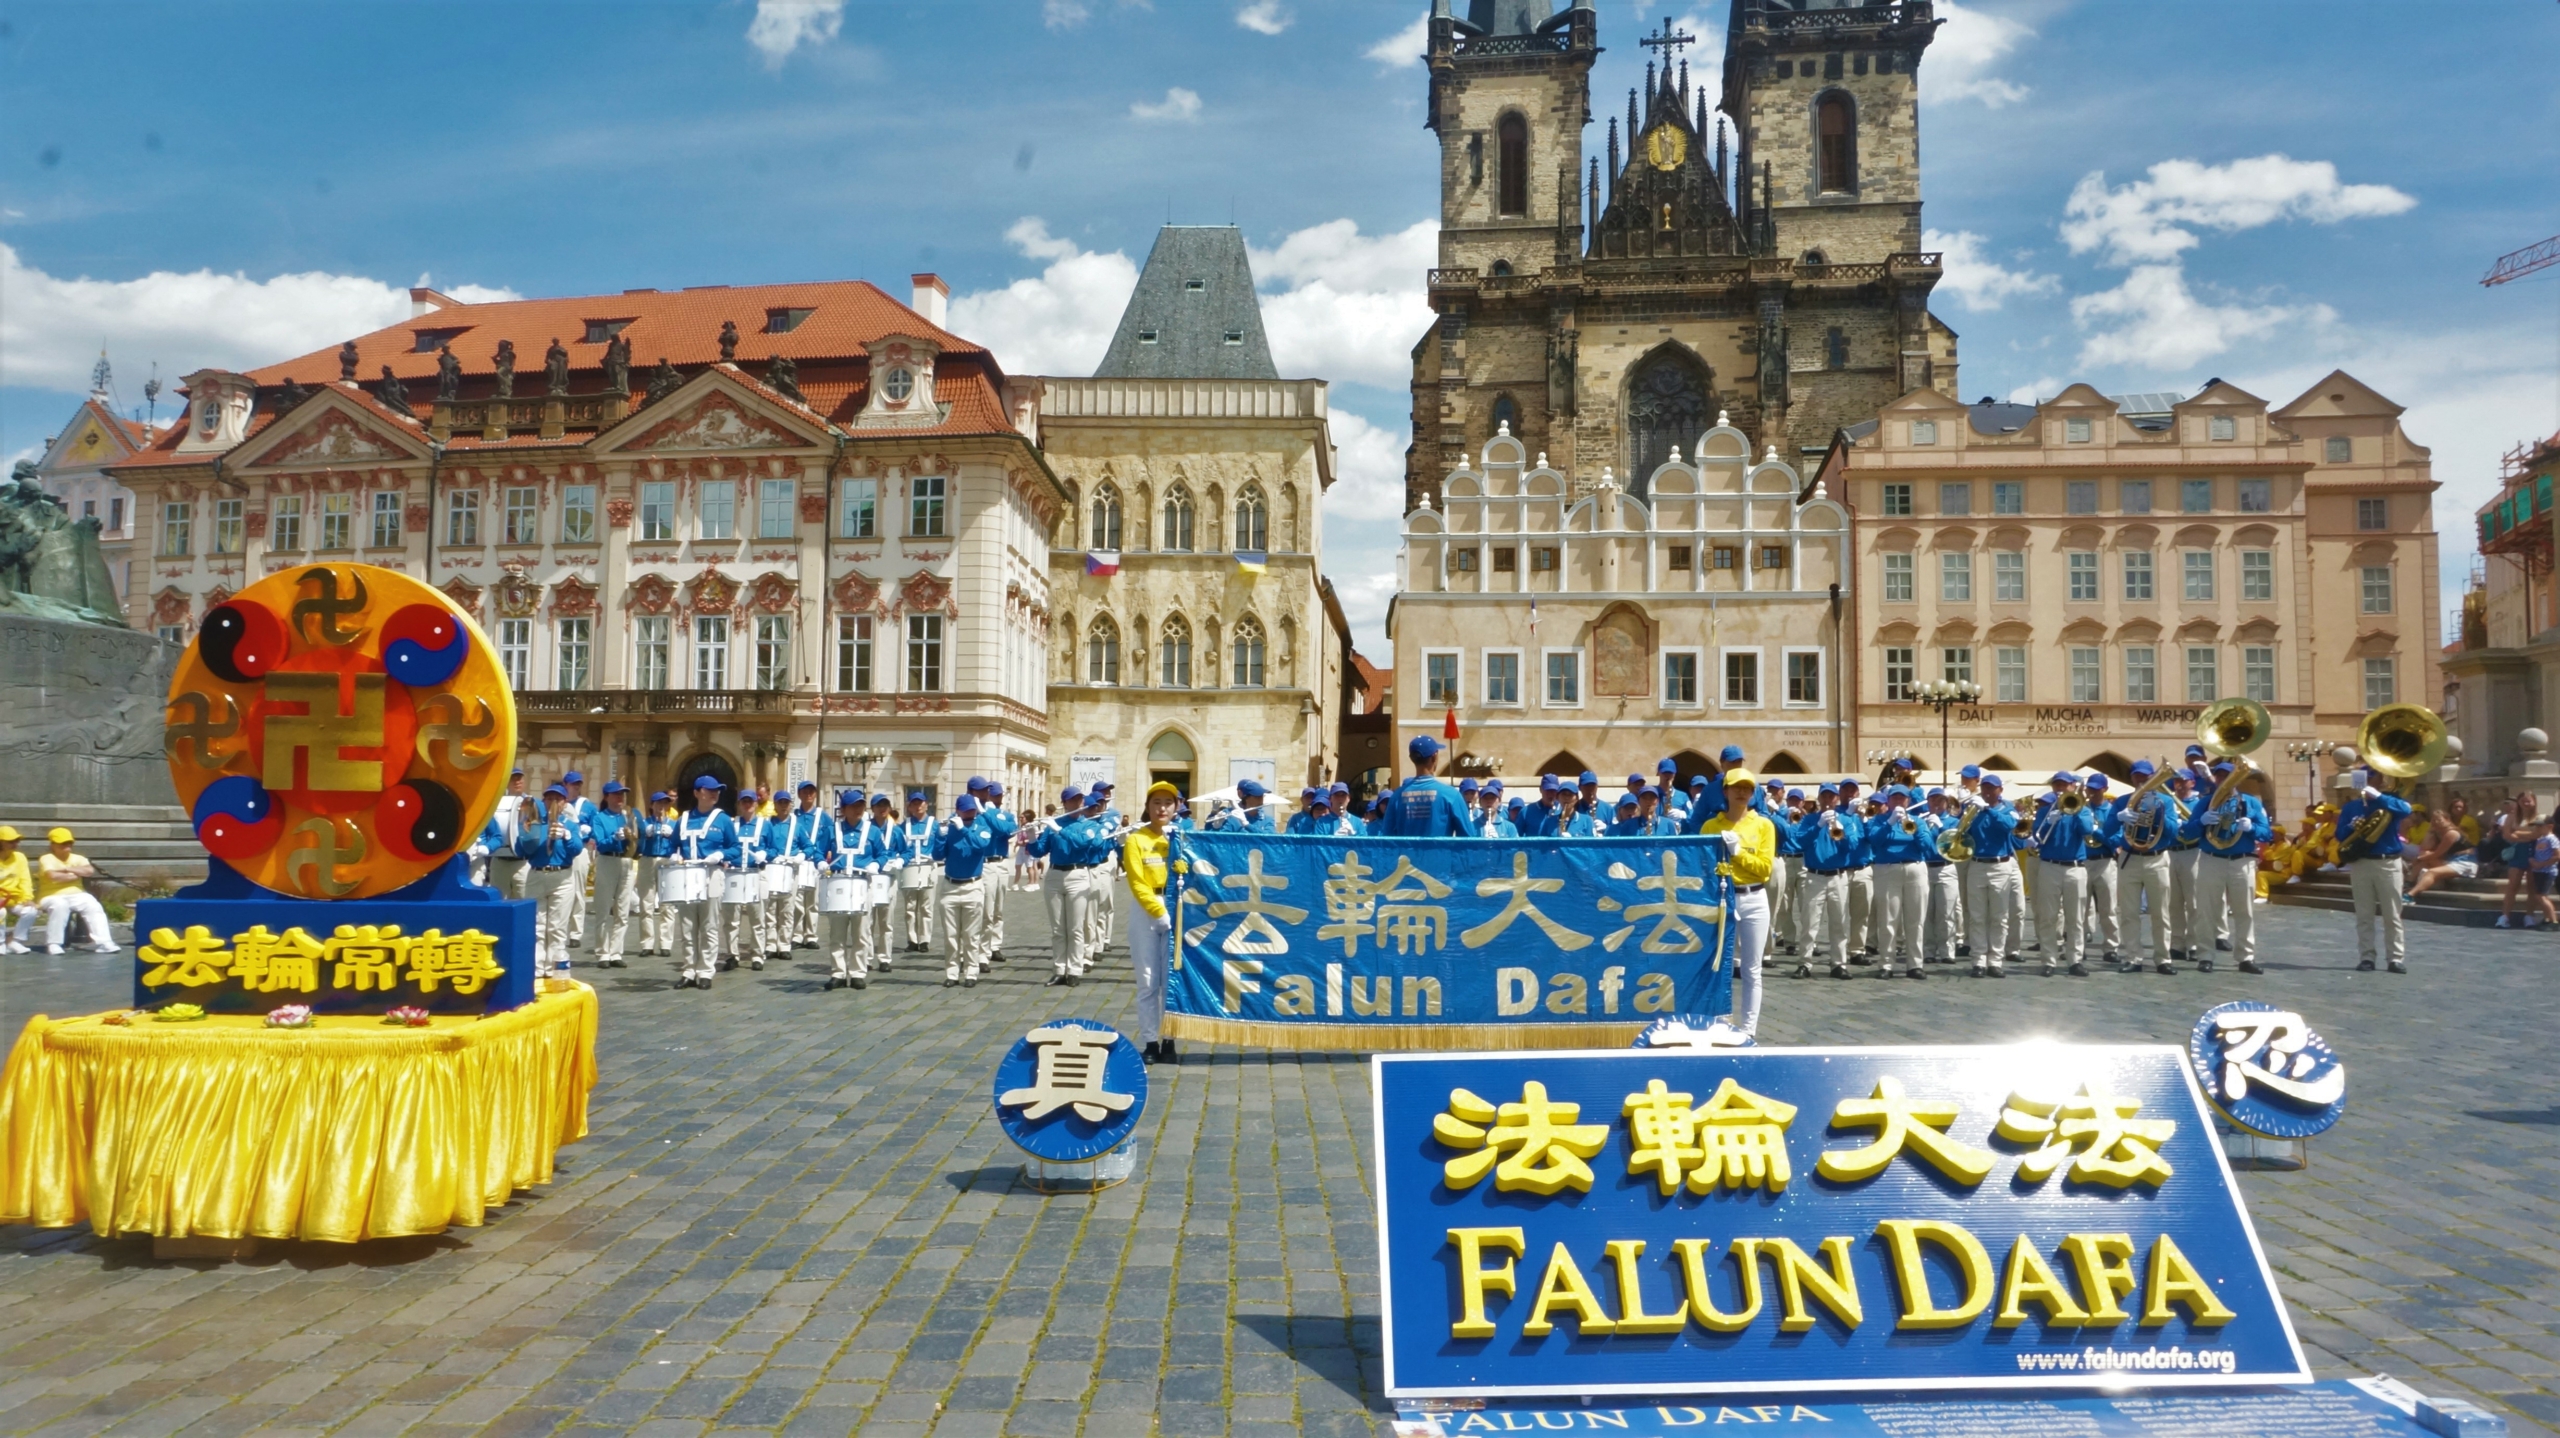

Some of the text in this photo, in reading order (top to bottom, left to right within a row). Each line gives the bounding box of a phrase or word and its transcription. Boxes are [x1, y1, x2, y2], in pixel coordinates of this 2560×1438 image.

[2036, 708, 2093, 722] MUCHA
[1993, 740, 2000, 749] U
[1080, 772, 1105, 782] WAS
[1182, 848, 1719, 958] 法輪大法
[138, 925, 505, 994] 法輪常轉
[1223, 960, 1675, 1016] Falun Dafa
[1000, 1024, 1135, 1122] 真
[1434, 1076, 2176, 1196] 法輪大法
[1447, 1219, 2236, 1338] FALUN DAFA
[2017, 1346, 2235, 1373] www.falundafa.org
[1419, 1404, 1833, 1431] FALUN DAFA
